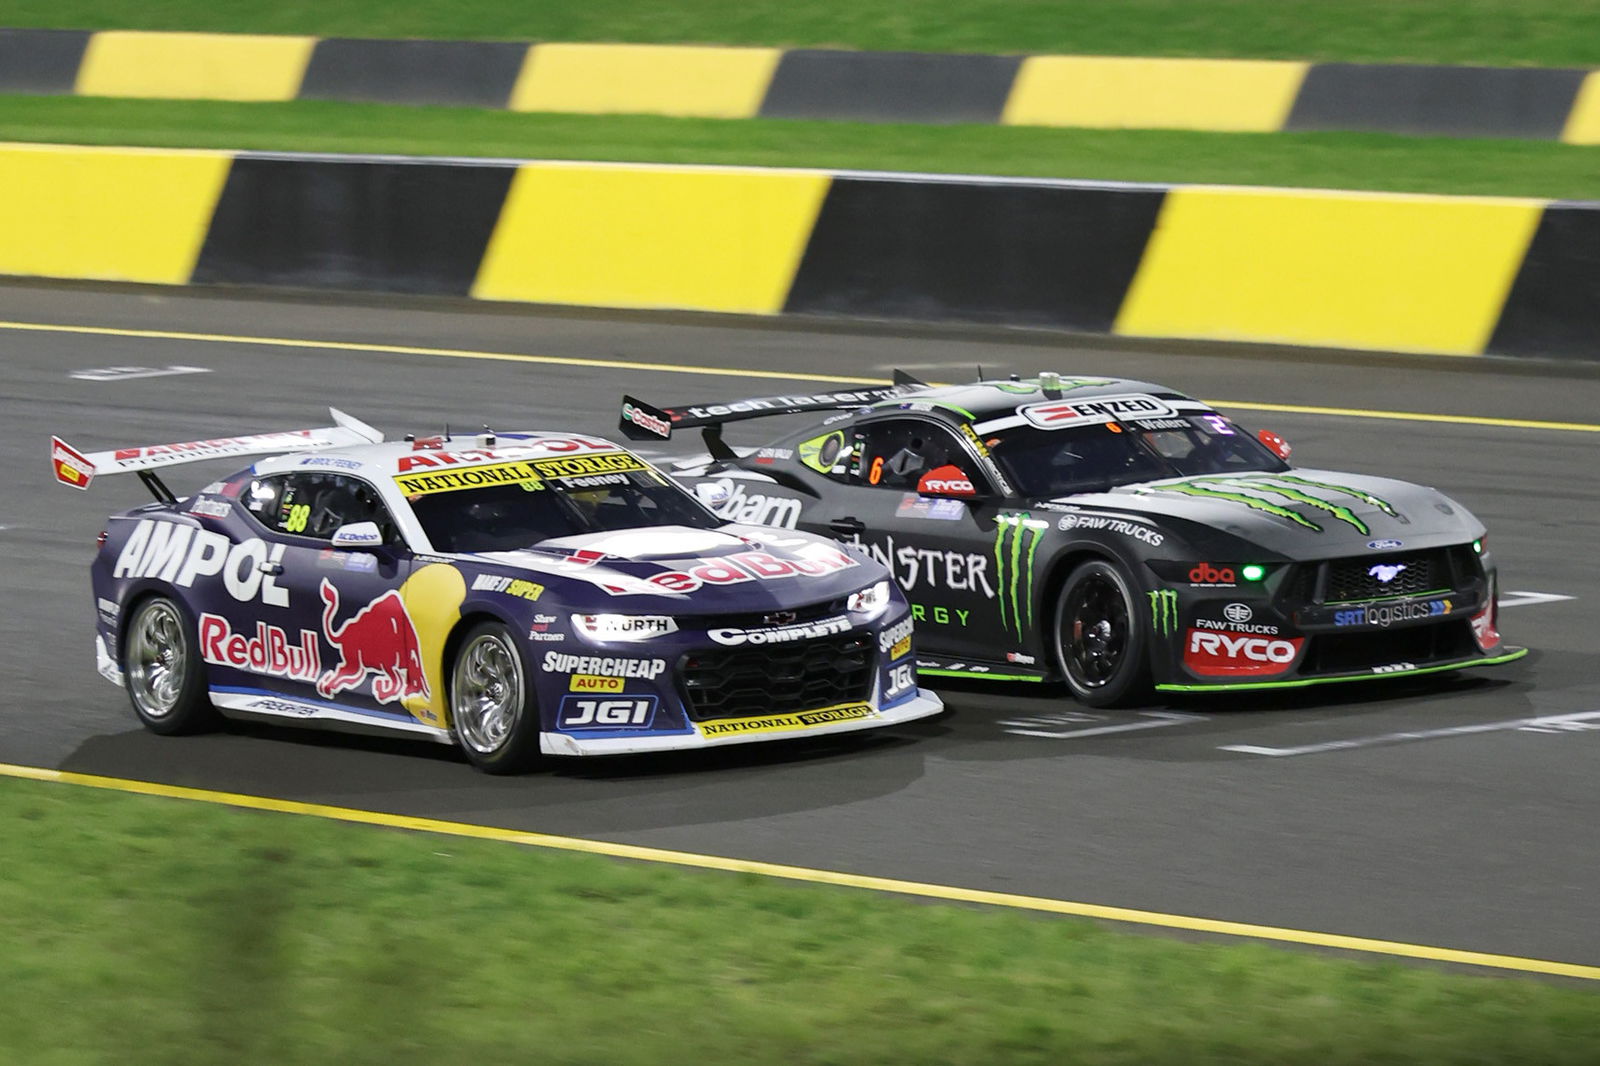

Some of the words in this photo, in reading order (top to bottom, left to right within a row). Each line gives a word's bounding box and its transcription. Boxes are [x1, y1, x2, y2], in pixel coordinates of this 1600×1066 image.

[688, 395, 774, 418] tech
[776, 389, 876, 408] laser
[1071, 400, 1158, 416] ENZED
[632, 407, 671, 438] Castrol
[401, 466, 532, 493] NATIONAL
[534, 453, 645, 478] STORAGE
[560, 473, 630, 489] Feeney
[869, 456, 884, 484] 6
[925, 480, 974, 491] RYCO
[286, 504, 311, 532] 88
[1109, 520, 1164, 547] TRUCKS
[113, 519, 289, 607] AMPOL
[1189, 563, 1236, 584] dba
[911, 604, 970, 626] RGY
[1196, 618, 1227, 630] FAW
[1227, 622, 1279, 635] TRUCKS
[528, 630, 565, 642] Partners
[707, 618, 853, 646] COMPLETE
[1191, 631, 1296, 663] RYCO
[542, 651, 666, 681] SUPERCHEAP
[576, 678, 619, 689] AUTO
[565, 701, 649, 725] JGI
[703, 717, 798, 735] NATIONAL
[802, 706, 874, 724] STORAGE
